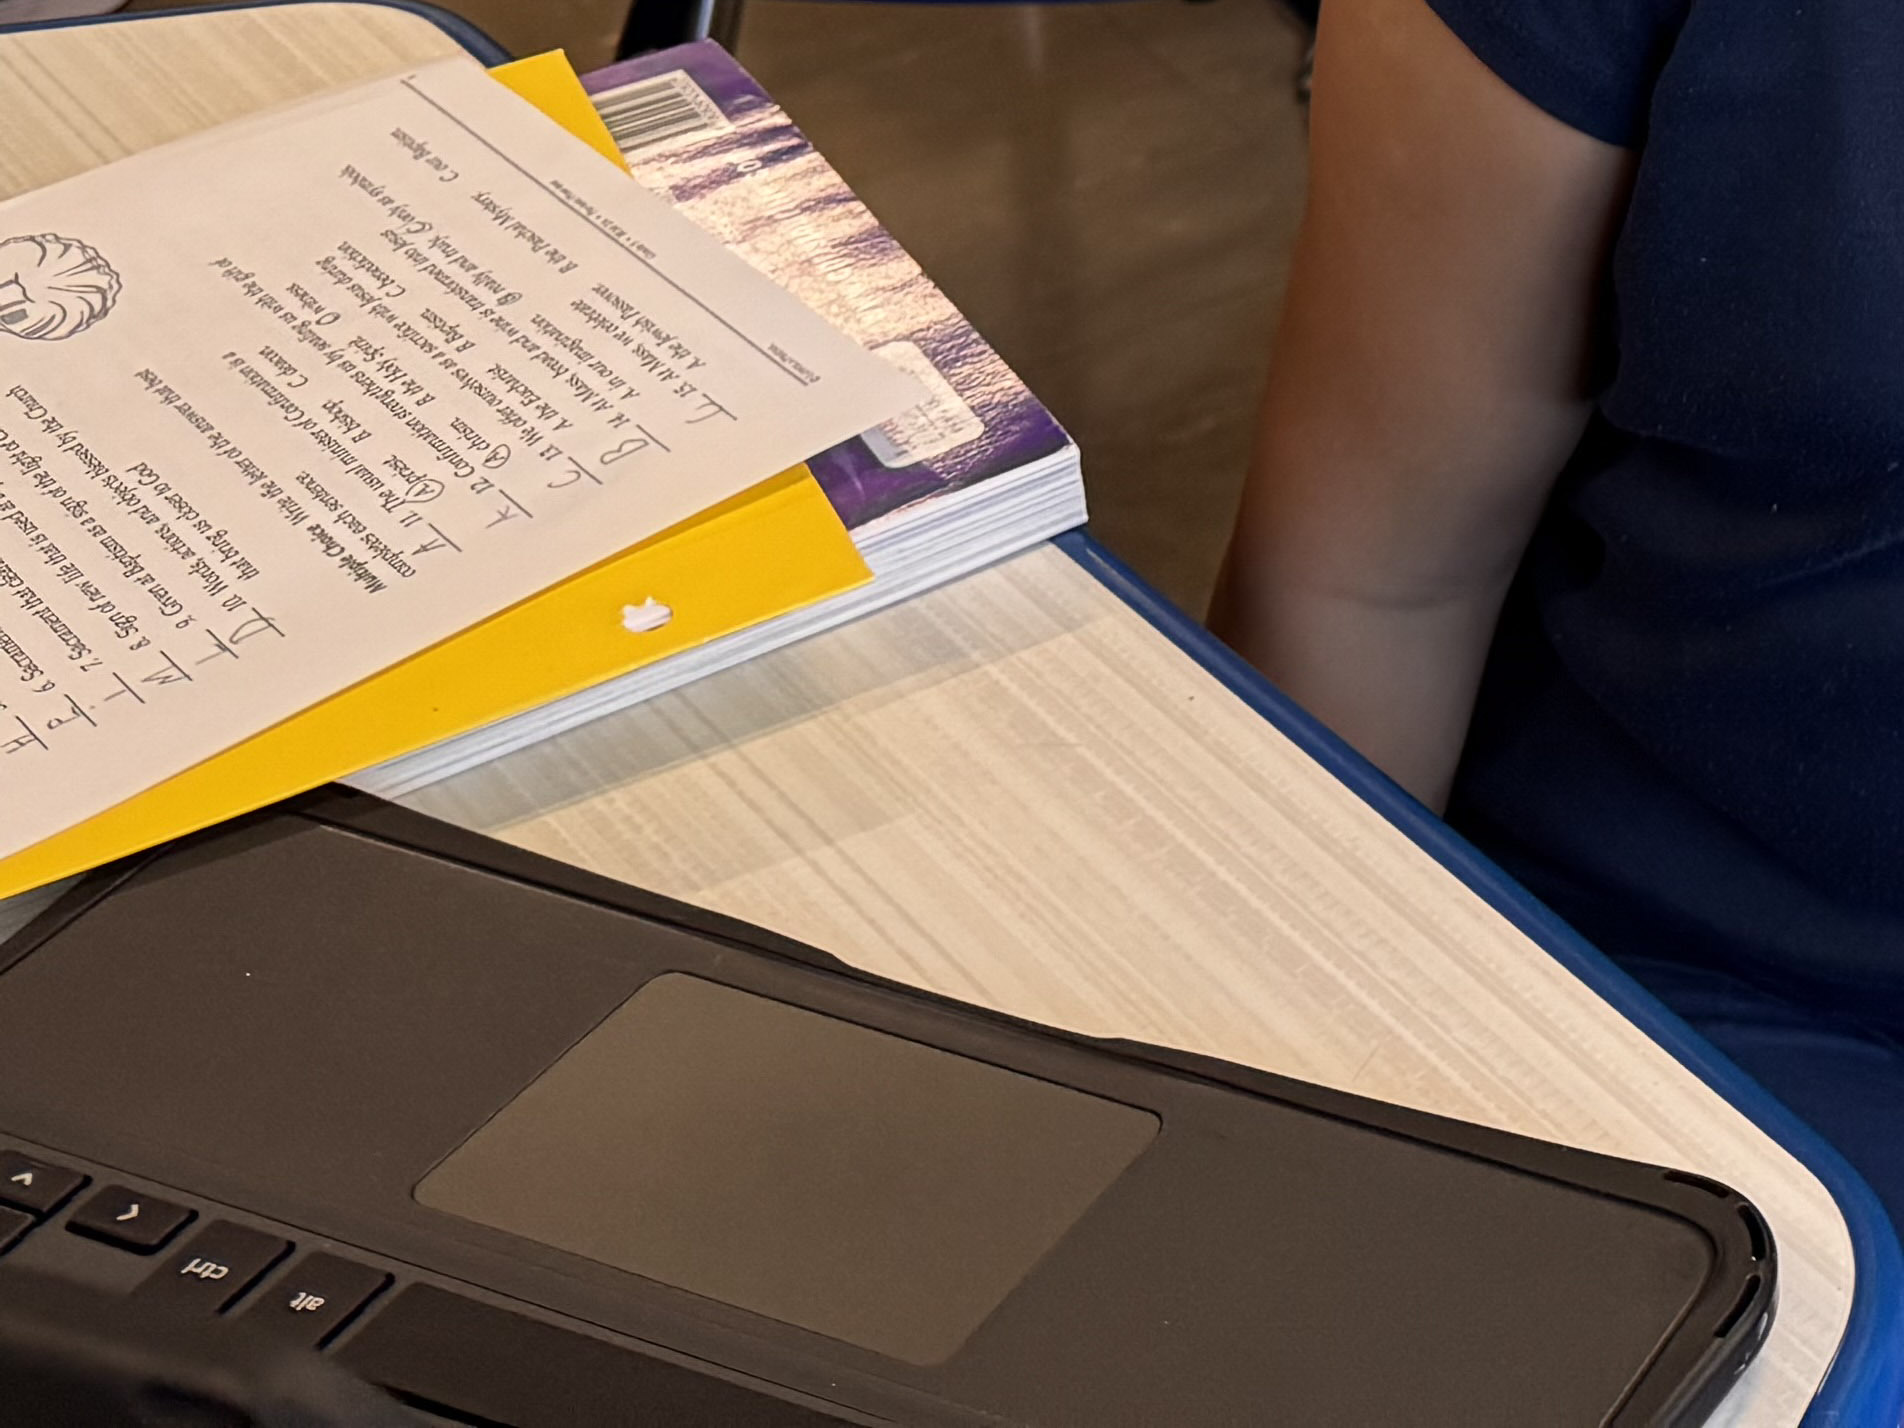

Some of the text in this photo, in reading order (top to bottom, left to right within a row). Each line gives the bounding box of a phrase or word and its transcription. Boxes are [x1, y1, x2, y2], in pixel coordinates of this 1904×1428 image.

[424, 156, 449, 172] our
[376, 195, 396, 207] as
[388, 204, 416, 225] only
[379, 229, 415, 252] Jesus
[504, 221, 551, 253] Paschal
[208, 257, 233, 268] of
[404, 247, 430, 267] into
[447, 255, 479, 273] and
[544, 248, 567, 265] the
[221, 266, 256, 283] gift
[315, 256, 353, 286] during
[472, 270, 506, 294] really
[242, 280, 264, 298] the
[346, 283, 382, 308] Jesus
[417, 263, 485, 311] transformed
[254, 293, 284, 314] with
[367, 303, 399, 324] with
[478, 308, 496, 318] is
[278, 311, 298, 325] us
[489, 315, 520, 338] wine
[570, 299, 619, 333] celebrate
[291, 320, 332, 352] sealing
[393, 321, 438, 354] sacrifice
[612, 330, 634, 347] we
[632, 316, 678, 347] Jewish
[508, 334, 541, 353] and
[668, 342, 692, 360] the
[221, 351, 237, 360] a
[228, 357, 246, 368] is
[322, 348, 346, 366] by
[336, 360, 357, 373] us
[430, 351, 447, 360] a
[438, 358, 458, 370] as
[529, 351, 570, 379] bread
[376, 357, 408, 383] Holy
[587, 360, 614, 378] our
[656, 367, 680, 382] At
[239, 366, 305, 422] Confirmation
[400, 378, 424, 396] the
[450, 368, 503, 407] ourselves
[607, 375, 627, 391] in
[6, 385, 48, 420] Church
[350, 371, 412, 420] strengthens
[590, 397, 614, 412] At
[495, 406, 528, 428] offer
[535, 402, 559, 421] the
[40, 416, 64, 434] the
[291, 417, 318, 431] of
[55, 430, 78, 448] by
[310, 429, 358, 466] minister
[405, 417, 475, 478] Confirmation
[519, 426, 544, 447] We
[10, 450, 43, 476] light
[62, 442, 110, 480] blessed
[599, 438, 650, 466] B
[32, 470, 57, 489] the
[134, 368, 387, 594] Multiple Choice Write the letter of the answer that best
[345, 463, 385, 492] usual
[546, 469, 582, 489] C
[40, 486, 67, 499] of
[101, 474, 141, 507] objects
[153, 482, 172, 497] to
[59, 496, 89, 519] sign
[164, 493, 200, 521] closer
[378, 489, 410, 514] The
[3, 510, 38, 536] used
[79, 516, 96, 526] a
[127, 504, 160, 525] and
[333, 510, 367, 535] each
[86, 524, 108, 538] as
[192, 519, 213, 535] us
[28, 533, 49, 548] is
[154, 523, 196, 560] actions,
[205, 529, 240, 563] bring
[36, 542, 67, 566] that
[99, 535, 145, 578] Baptism
[360, 533, 416, 578] completes
[56, 562, 84, 584] life
[133, 573, 156, 586] at
[188, 557, 229, 597] Words,
[229, 556, 260, 581] that
[12, 586, 44, 611] that
[74, 580, 106, 603] new
[147, 583, 183, 617] Given
[87, 600, 116, 614] of
[32, 606, 92, 661] Sacrament
[108, 611, 139, 639] Sign
[228, 618, 269, 645] D
[3, 634, 44, 682] Sacrame
[182, 1258, 230, 1281] ctrl
[288, 1291, 326, 1313] alt
